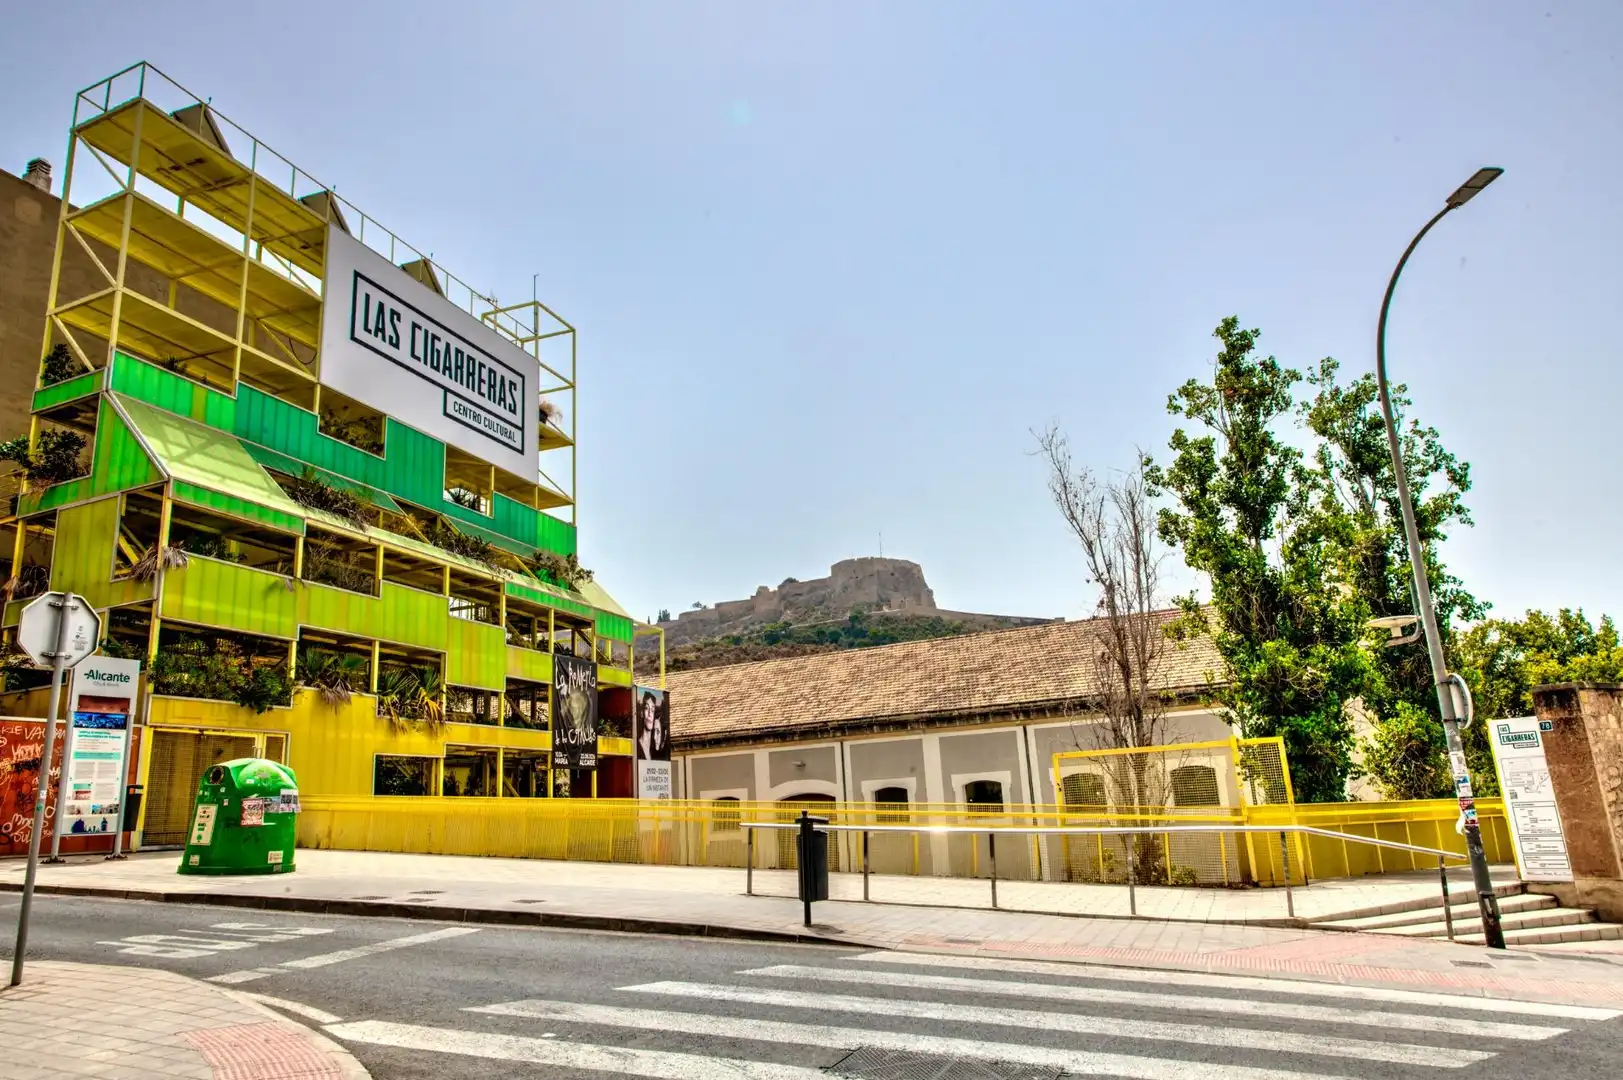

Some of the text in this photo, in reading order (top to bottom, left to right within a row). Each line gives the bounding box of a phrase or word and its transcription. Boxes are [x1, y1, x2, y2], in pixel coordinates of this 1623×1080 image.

[362, 292, 518, 416] LAS CIGARRERAS
[453, 401, 517, 443] CENTRO CULTURAL
[84, 669, 131, 683] Alicante
[1502, 733, 1535, 743] CIGARRERAS
